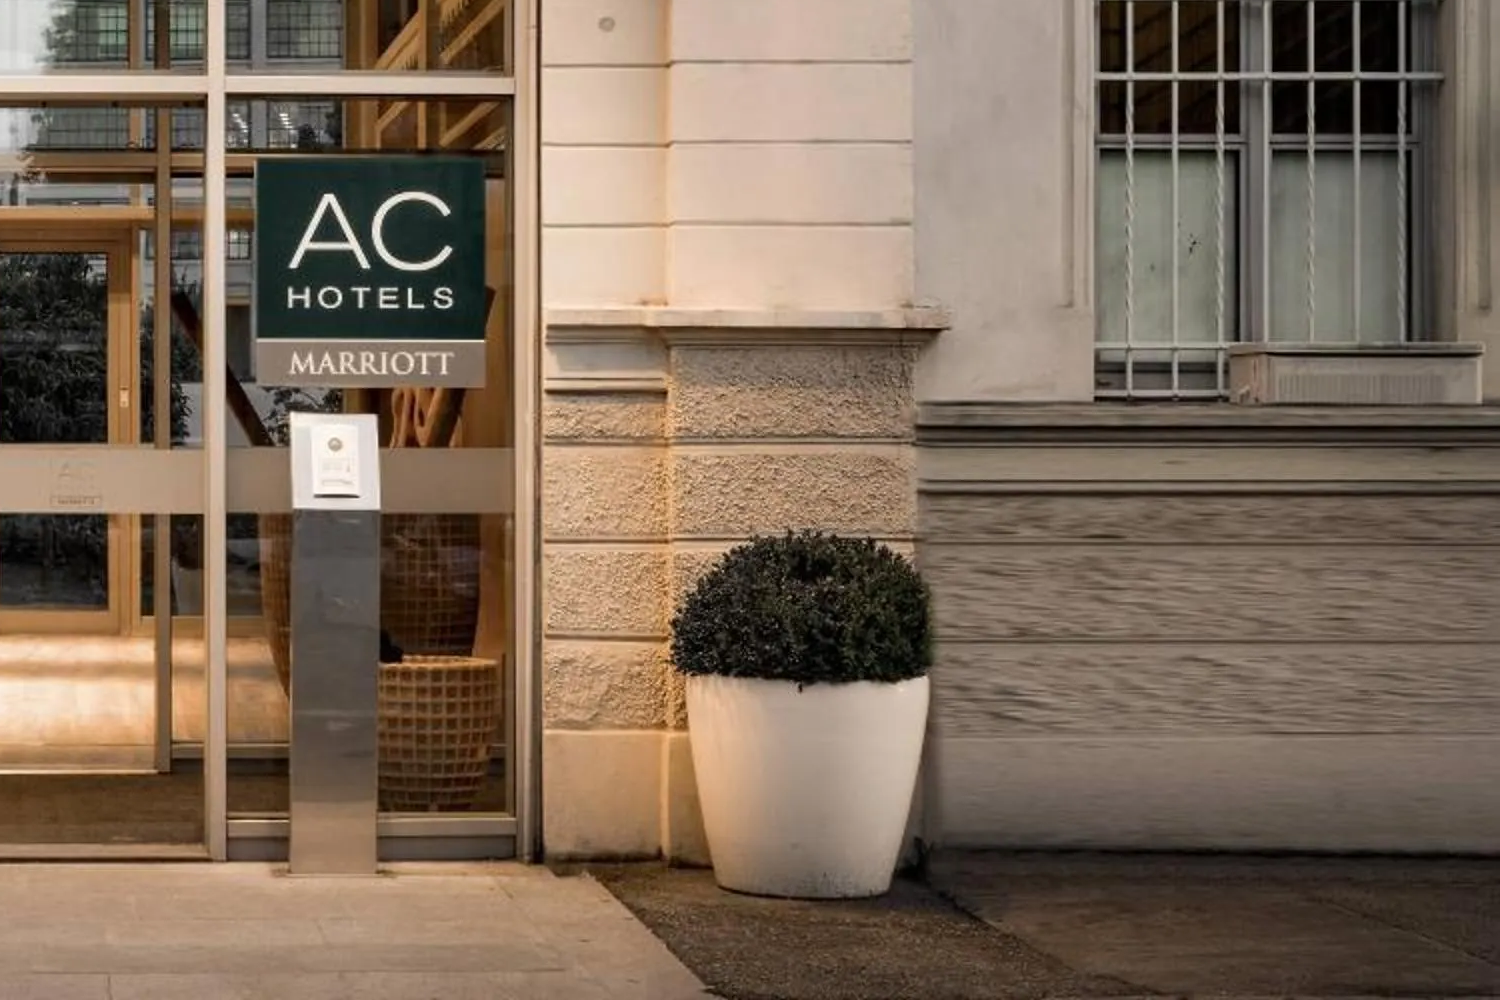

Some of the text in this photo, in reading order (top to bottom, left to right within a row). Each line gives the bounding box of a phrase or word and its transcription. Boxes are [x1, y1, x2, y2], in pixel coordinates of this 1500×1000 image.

[288, 191, 453, 271] AC
[287, 286, 454, 309] HOTELS
[288, 351, 455, 375] MARRIOTT
